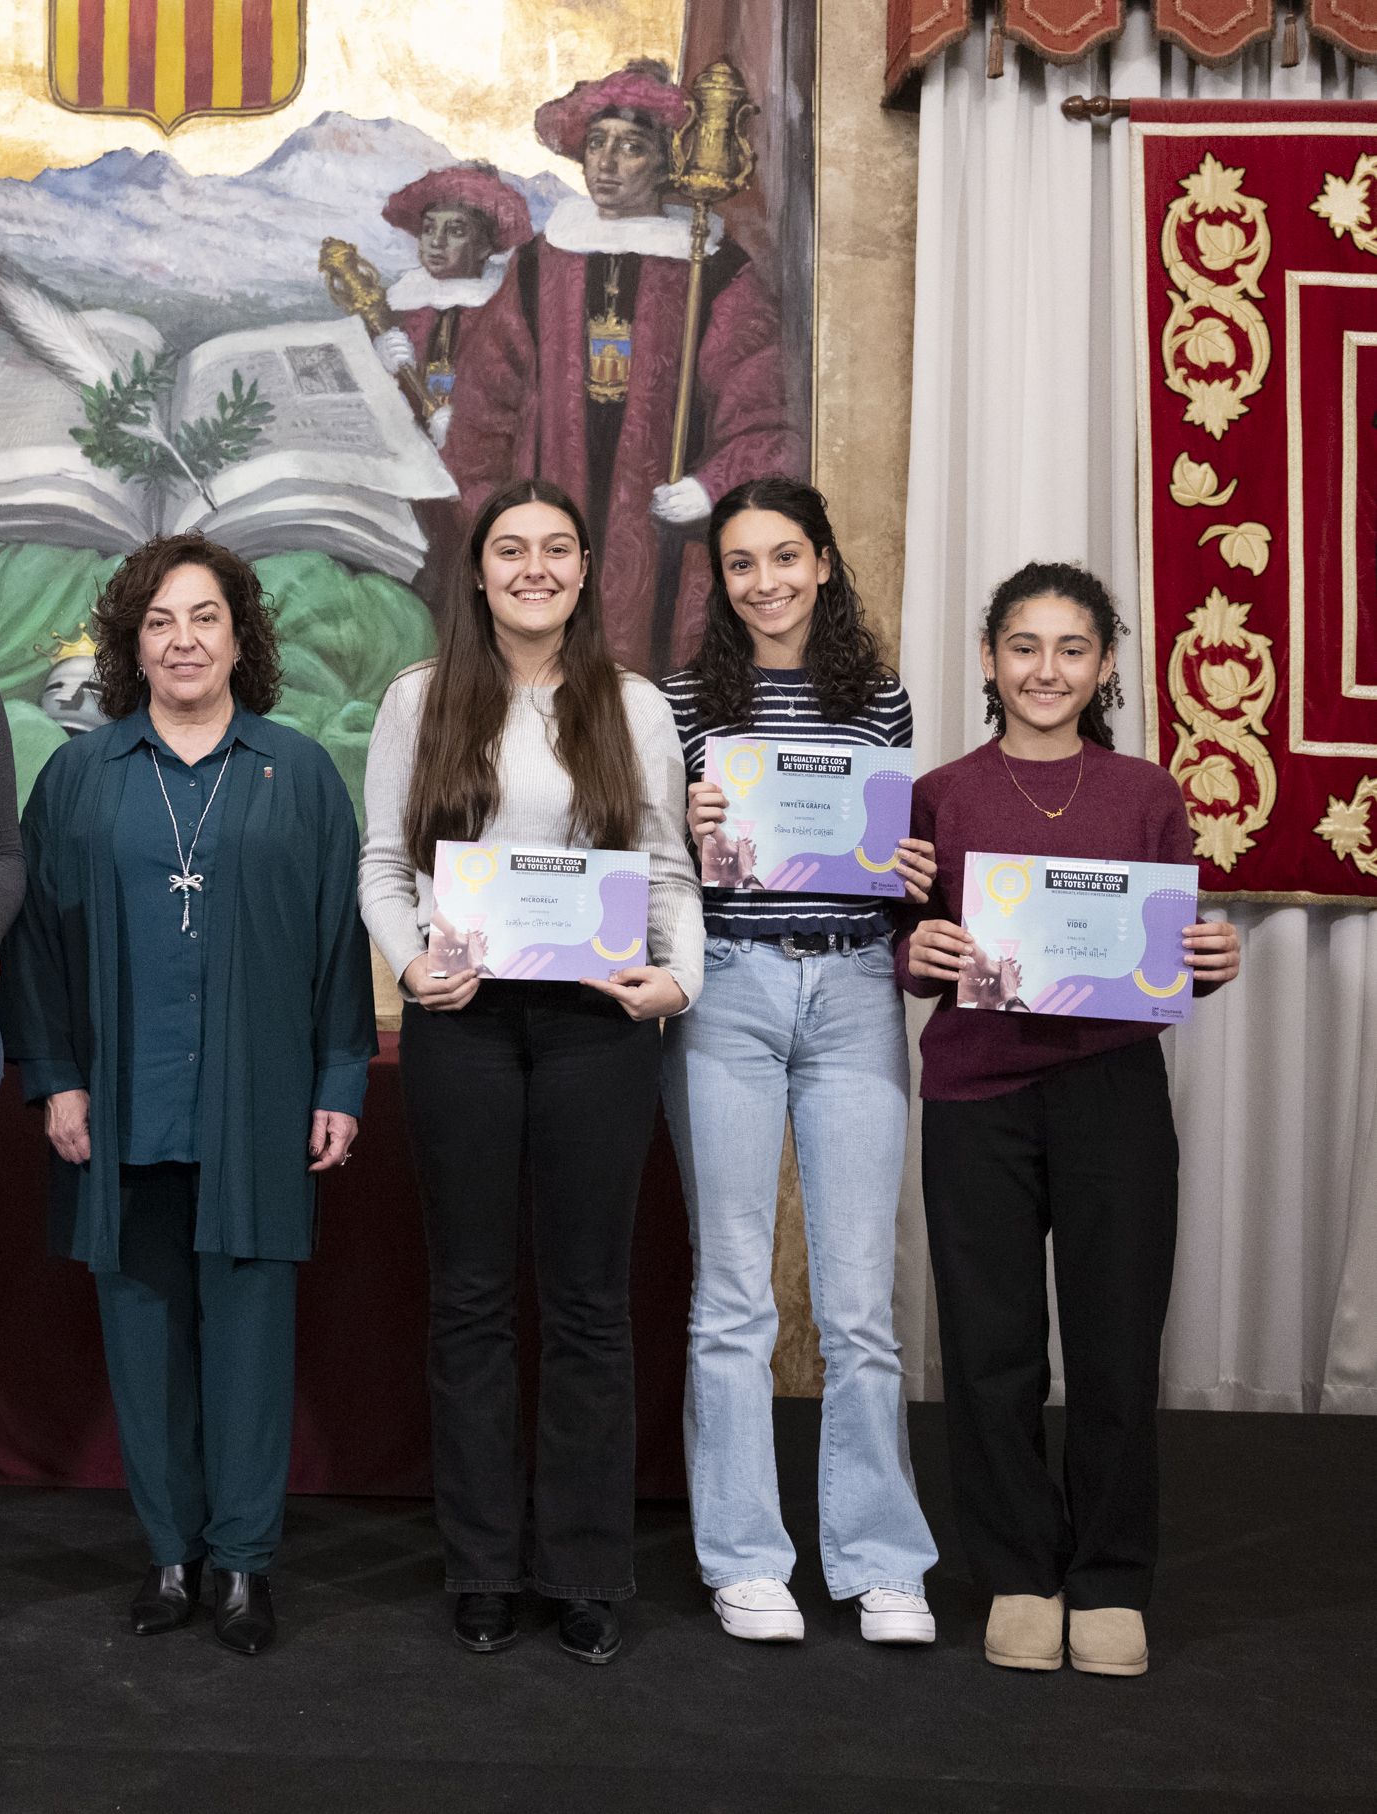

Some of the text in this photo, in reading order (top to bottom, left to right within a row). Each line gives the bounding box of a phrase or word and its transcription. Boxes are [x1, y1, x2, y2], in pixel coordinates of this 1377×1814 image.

[790, 755, 820, 764] IGUALTAT
[1060, 872, 1093, 881] IGUALTAT
[1094, 873, 1103, 882] ÉS
[1104, 875, 1123, 883] COSA
[1102, 883, 1121, 891] TOTS
